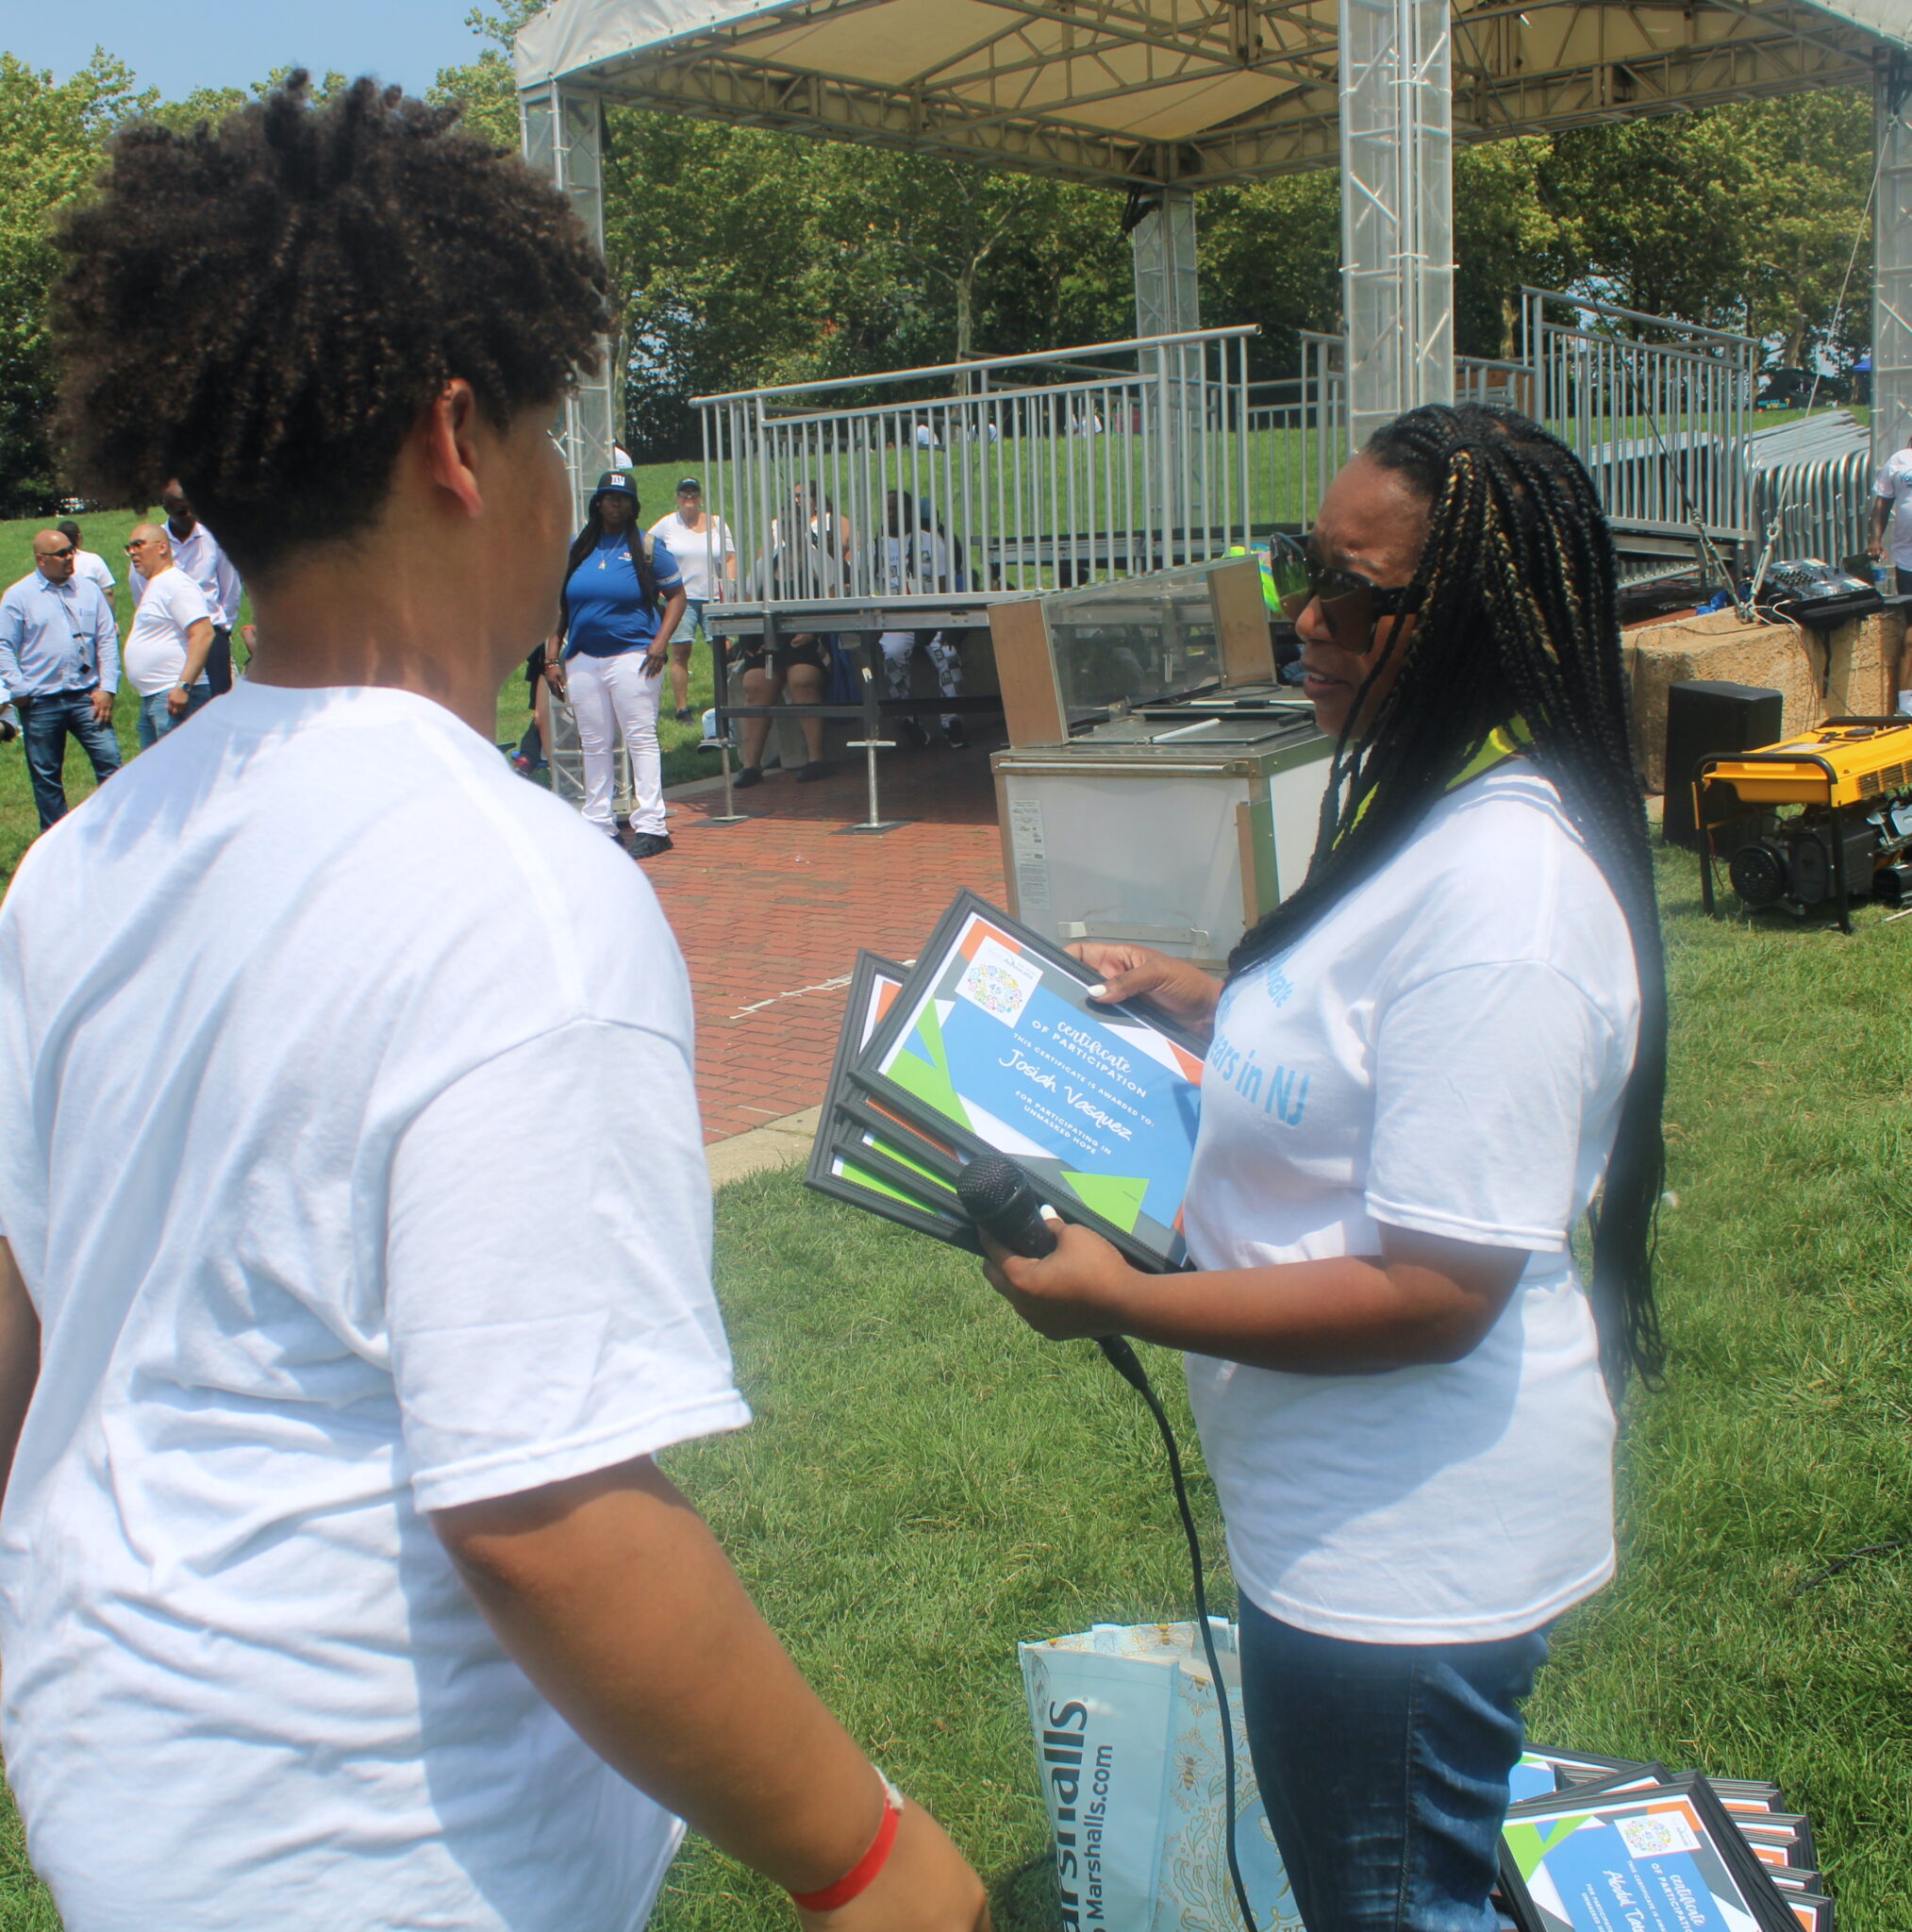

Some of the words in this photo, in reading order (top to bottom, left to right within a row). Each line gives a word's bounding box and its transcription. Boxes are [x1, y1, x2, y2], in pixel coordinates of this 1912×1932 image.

[1013, 1033, 1032, 1048] THIS
[1034, 1046, 1087, 1083] CERTIFICATE
[1088, 1081, 1096, 1090] IS
[1098, 1089, 1139, 1116] AWARDED
[1032, 1021, 1049, 1034] OF
[1053, 1033, 1147, 1098] PARTICIPATION
[1057, 1022, 1132, 1074] certificate
[998, 1048, 1057, 1093] Josiah
[1063, 1086, 1133, 1141] Vasquez
[1235, 1049, 1263, 1105] in
[1265, 1064, 1311, 1126] NJ
[1015, 1091, 1033, 1105] FOR
[1035, 1102, 1099, 1147] PARTICIPATING
[1102, 1145, 1112, 1156] IN
[1023, 1105, 1072, 1139] UNMASKED
[1072, 1137, 1097, 1155] HOPE
[1083, 1744, 1113, 1920] Marshalls.com
[1603, 1870, 1638, 1907] Abdul
[1634, 1874, 1656, 1910] CERTIFICATE
[1651, 1862, 1663, 1874] OF
[1670, 1874, 1705, 1927] certificate
